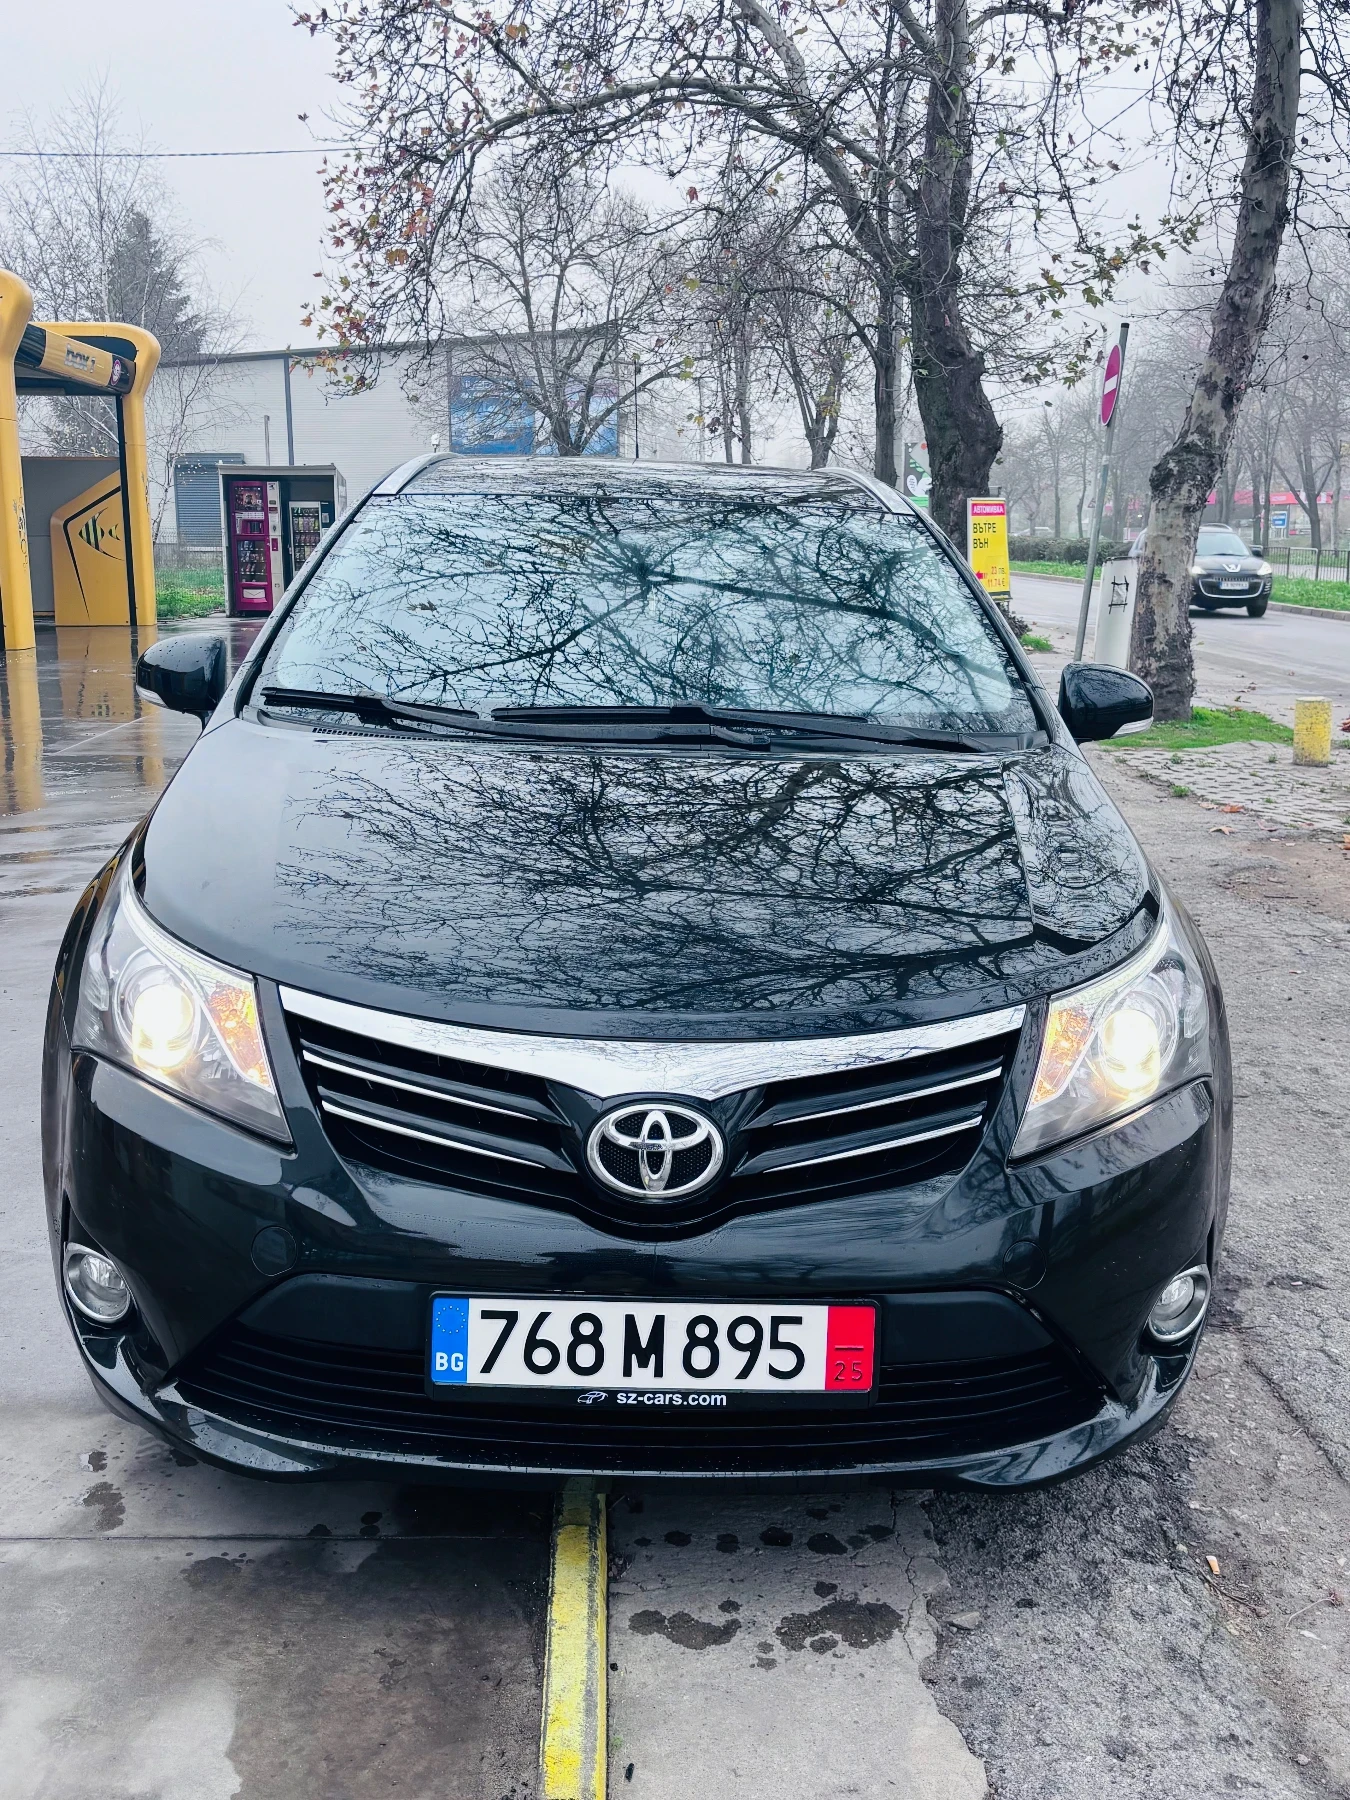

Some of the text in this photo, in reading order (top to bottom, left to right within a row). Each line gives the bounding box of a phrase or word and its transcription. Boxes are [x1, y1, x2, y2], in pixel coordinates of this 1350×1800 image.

[973, 505, 1004, 514] АВТОМИВКА
[973, 523, 997, 534] ВЪТРЕ
[973, 538, 989, 549] ВЪН
[479, 1310, 806, 1380] 768 M 895
[435, 1352, 464, 1372] BG
[834, 1360, 863, 1382] 25
[616, 1392, 727, 1406] sz-cars.com
